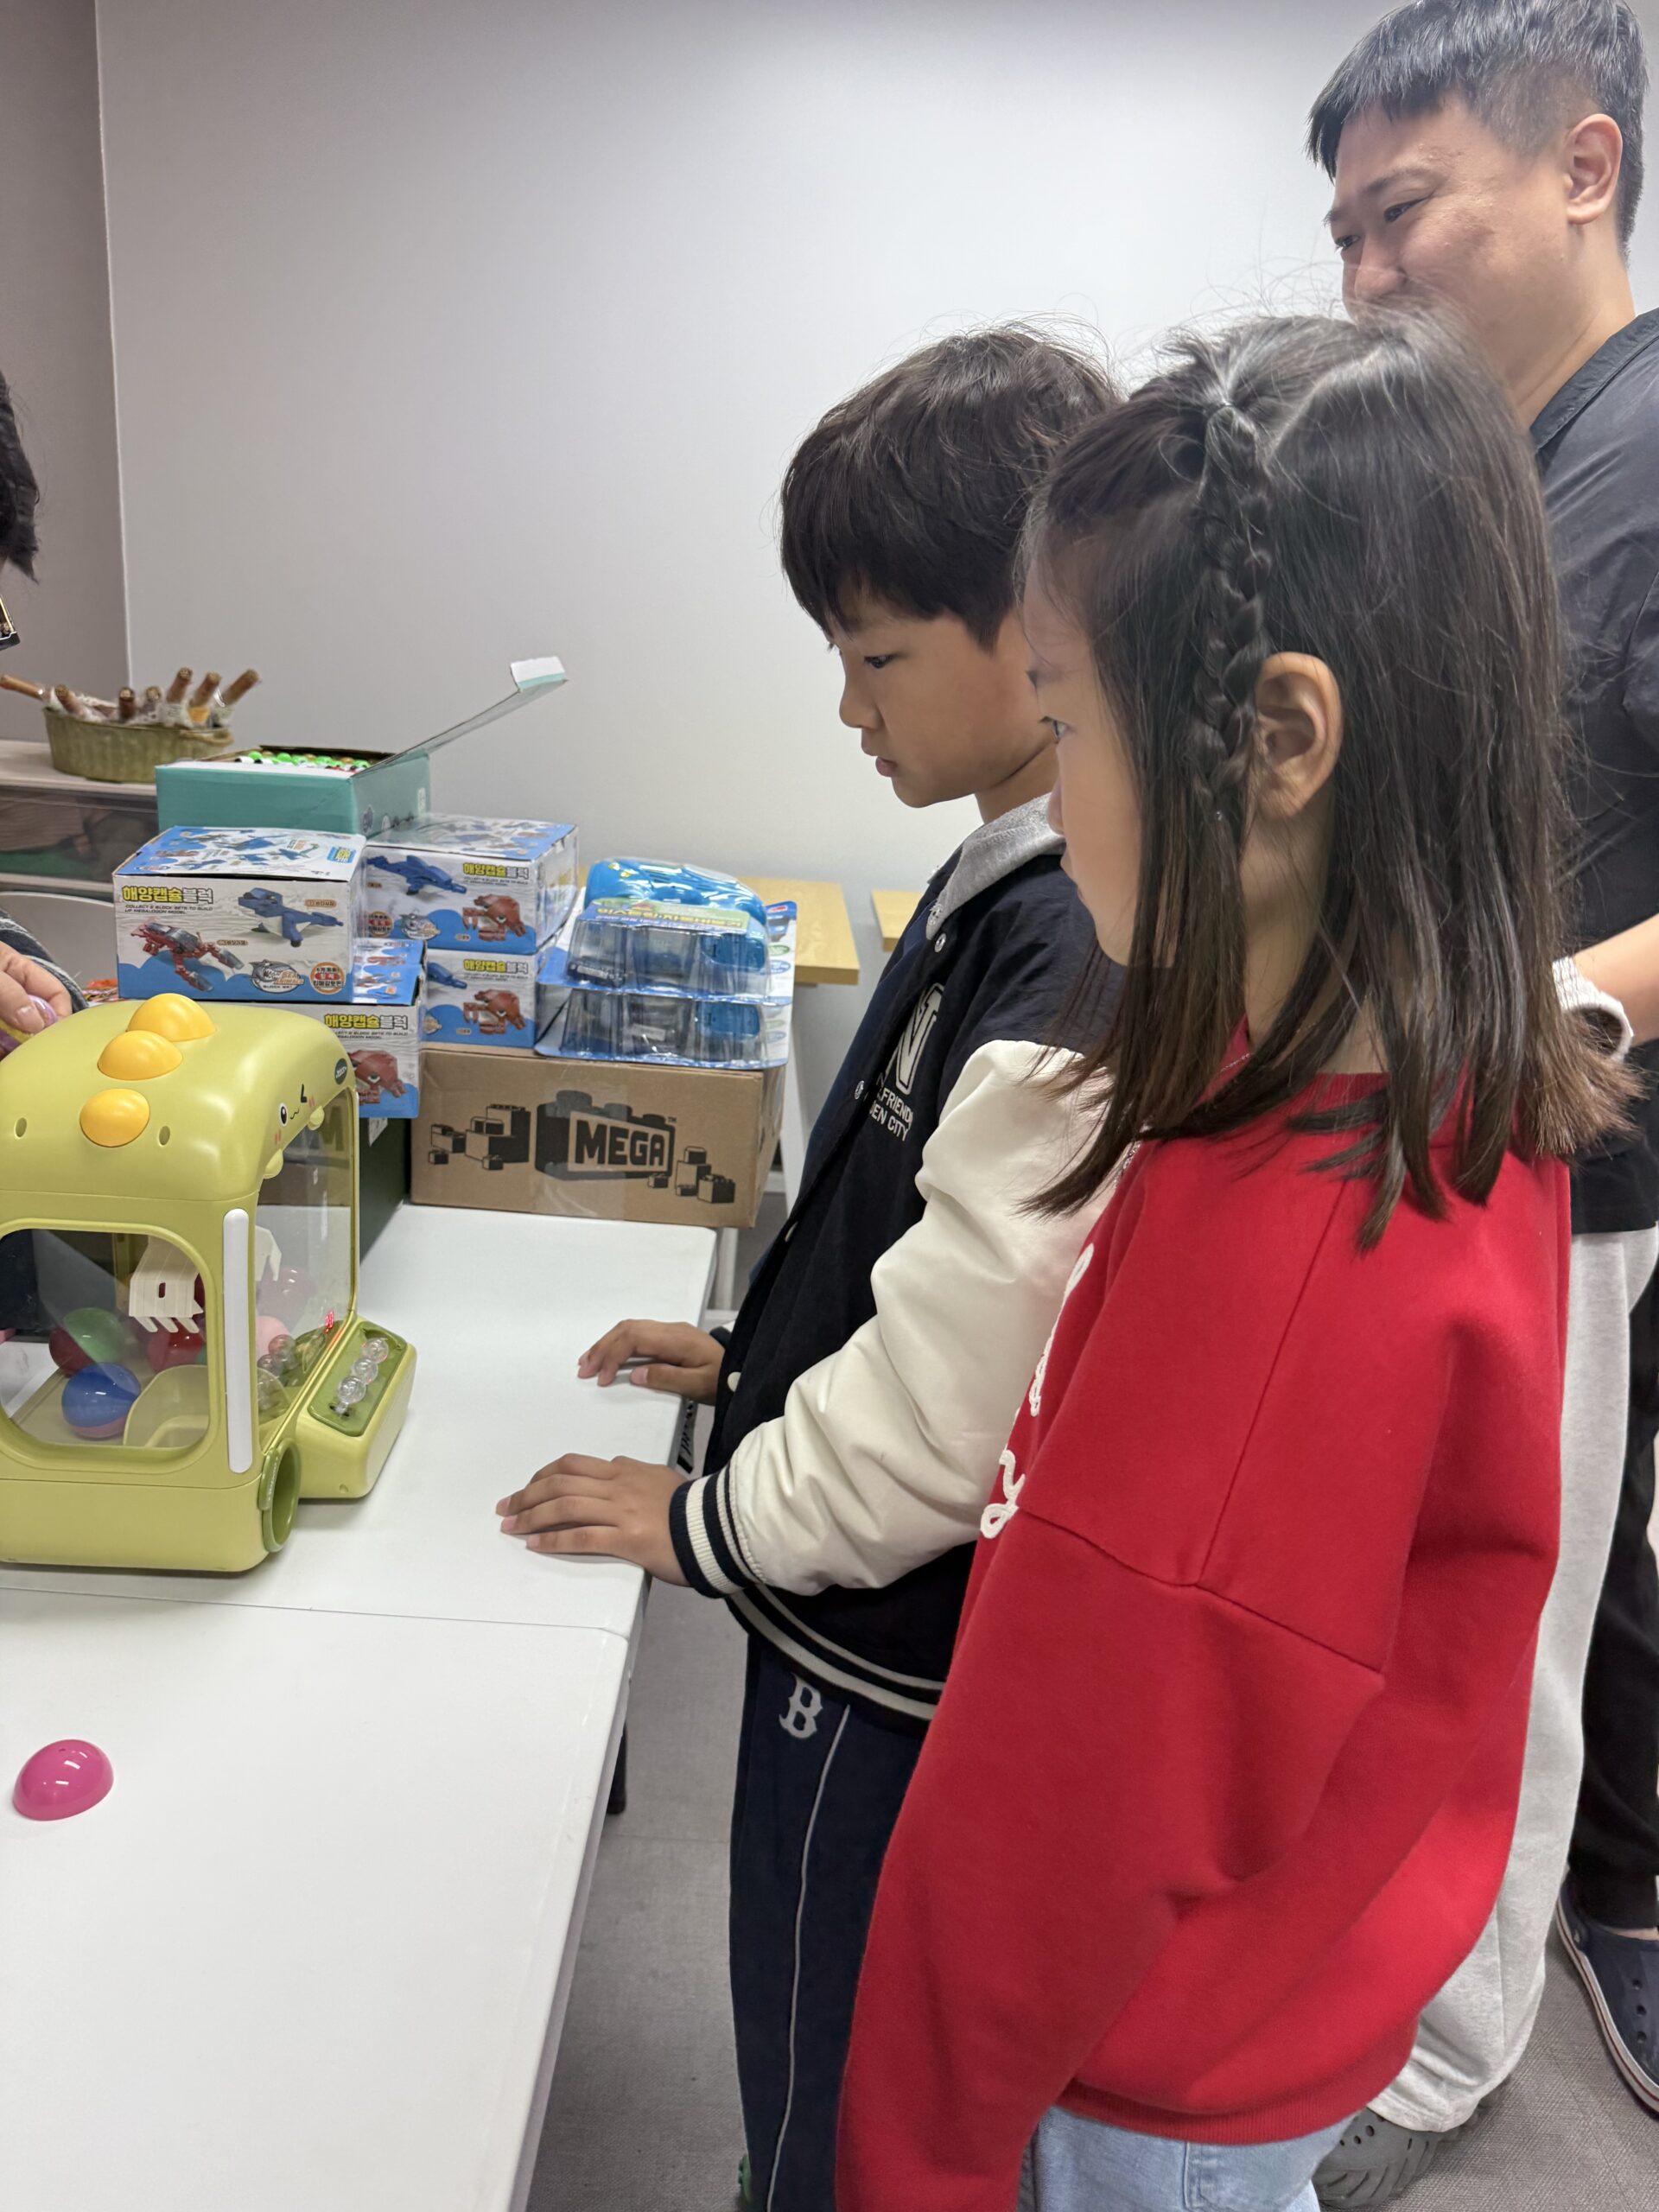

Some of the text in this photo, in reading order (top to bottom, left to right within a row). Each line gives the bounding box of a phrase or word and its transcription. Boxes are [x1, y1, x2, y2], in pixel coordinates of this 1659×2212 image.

[463, 862, 529, 880] 해양캡슐블럭
[122, 886, 213, 904] 해양캡슐블럭
[463, 959, 529, 975] 해양캡슐블럭
[324, 1013, 408, 1030] 해양캡슐블럭
[887, 1115, 909, 1141] CITY
[575, 1119, 665, 1166] MEGA
[779, 1672, 823, 1738] B
